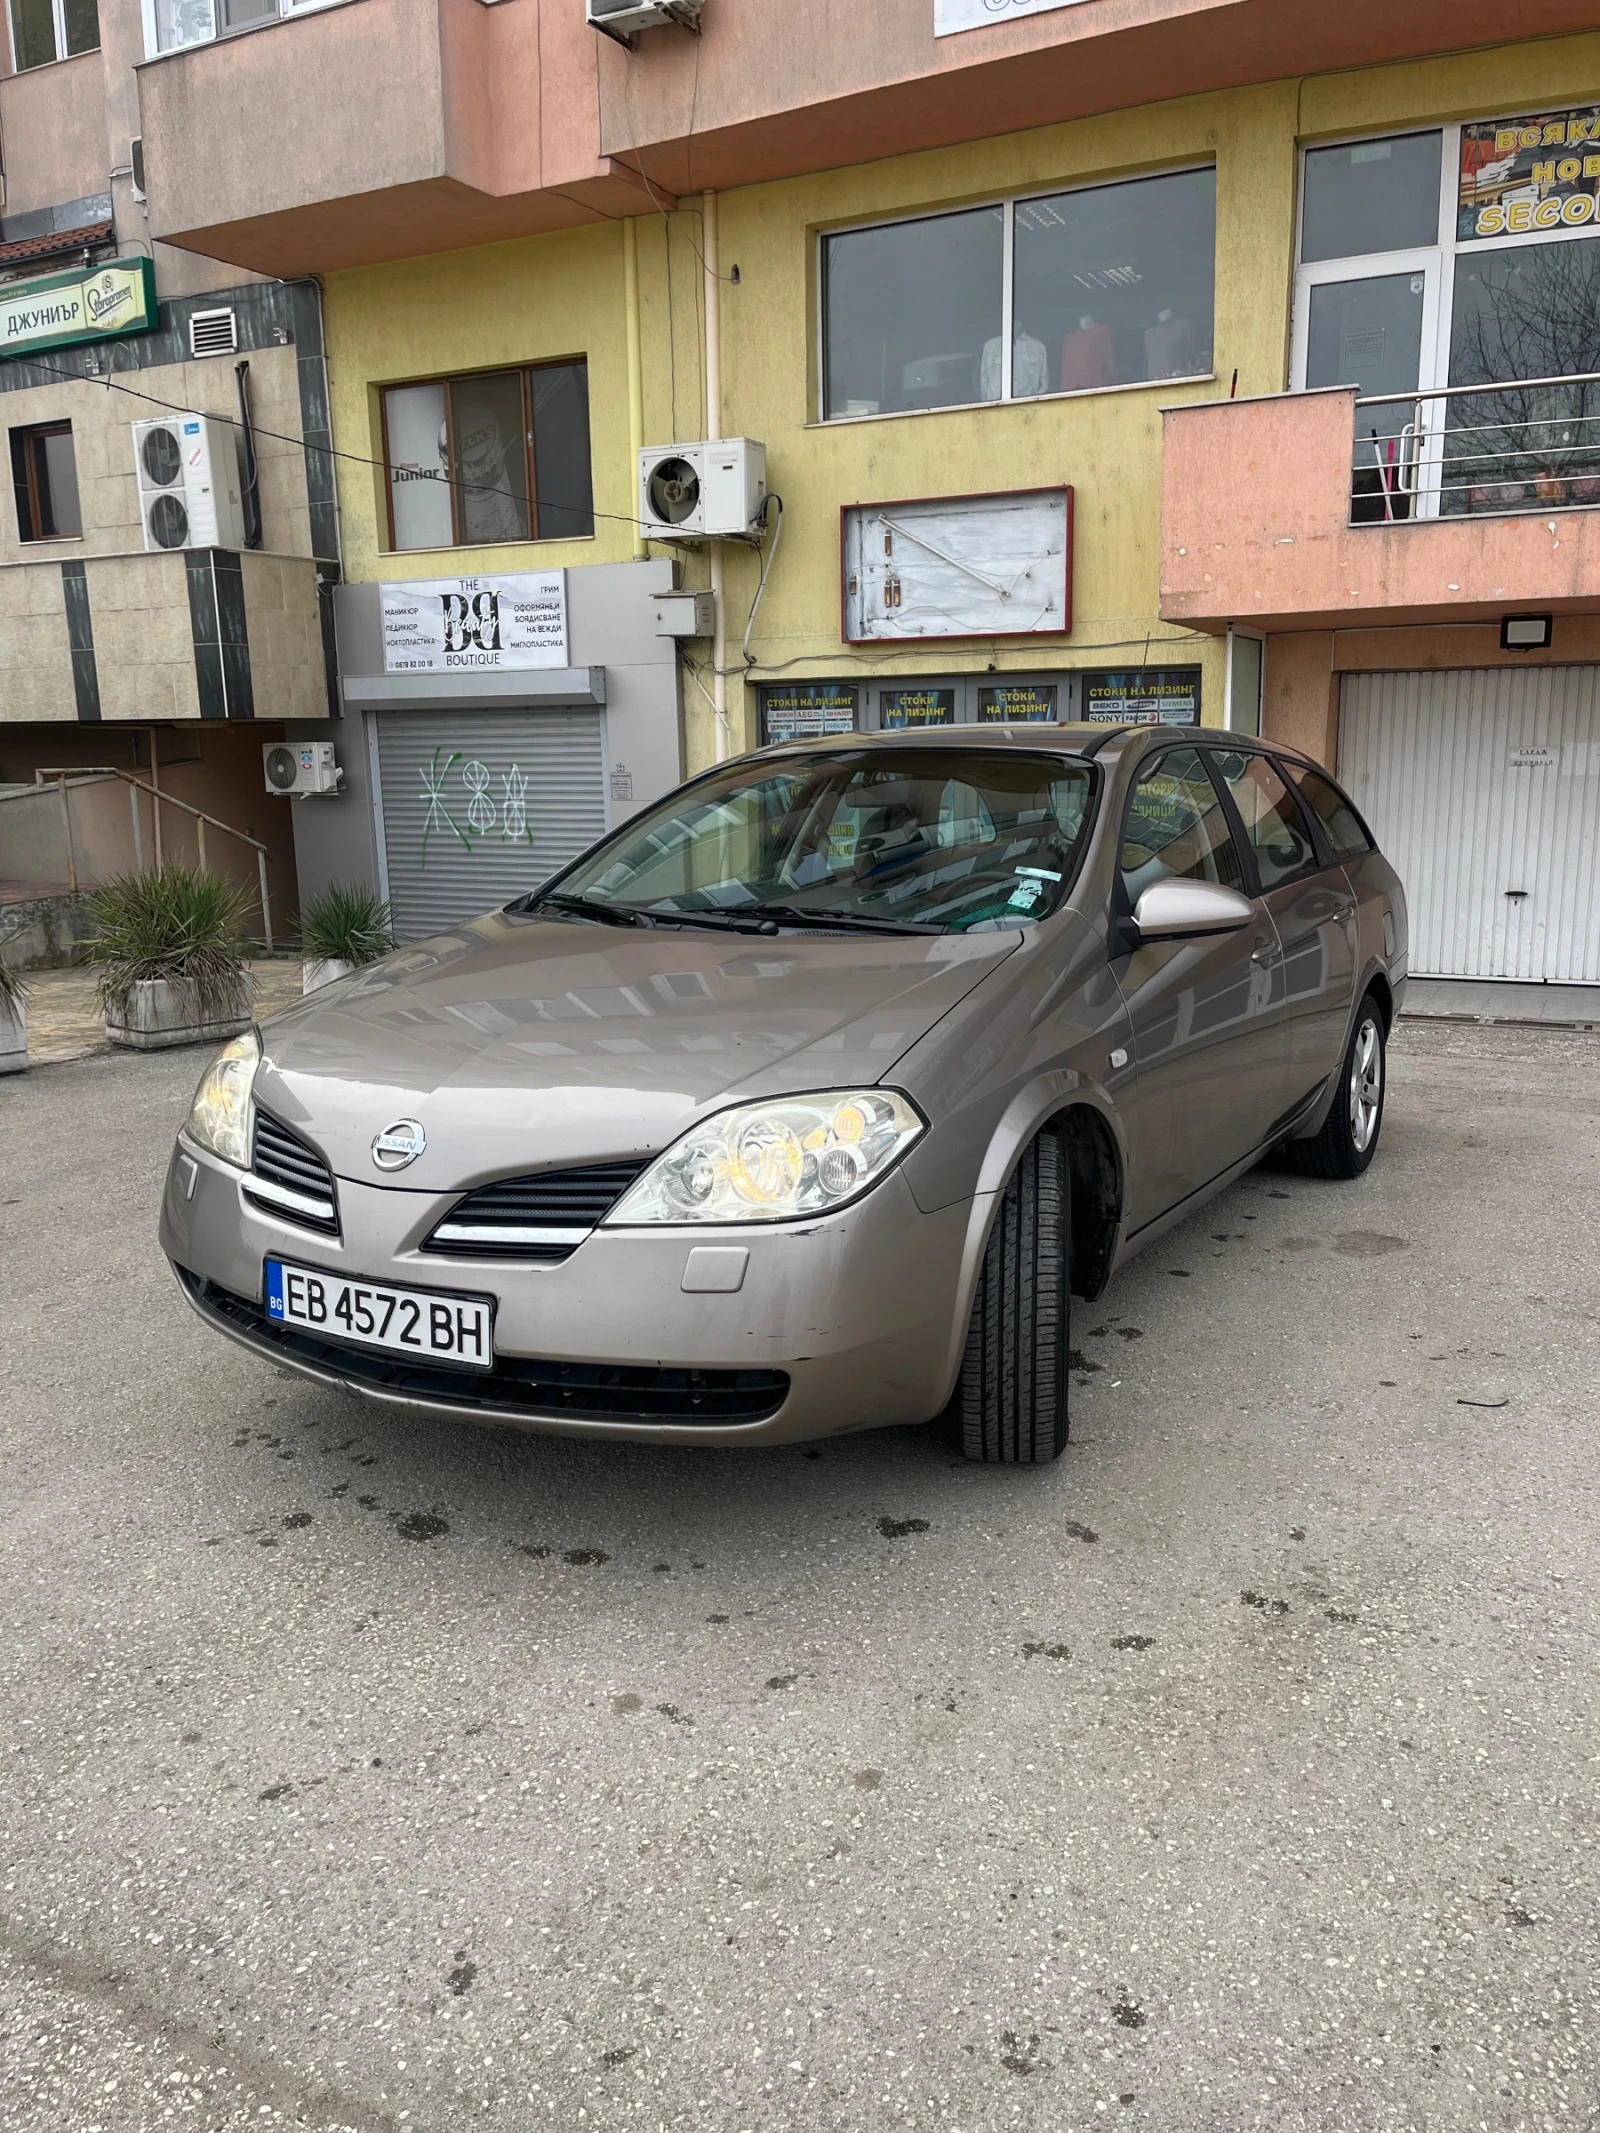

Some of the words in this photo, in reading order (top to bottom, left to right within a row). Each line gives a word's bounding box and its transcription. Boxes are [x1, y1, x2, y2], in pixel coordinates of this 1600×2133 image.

[1475, 193, 1600, 236] SECO
[87, 285, 134, 322] Staropramen
[7, 301, 80, 337] ДЖУНИЪР
[392, 467, 440, 483] Junior
[459, 580, 480, 591] THE
[385, 607, 419, 616] МАНИКЮР
[444, 605, 499, 641] Beauty
[515, 613, 561, 623] БОЯДИСВАНЕ
[386, 623, 418, 632] ПЕДИКЮР
[538, 625, 562, 633] ВЕЖДИ
[387, 637, 436, 646] НОКТОПЛАСТИКА
[510, 640, 564, 648] МИГЛОПЛАСТИКА
[446, 653, 501, 666] BOUTIQUE
[1089, 687, 1127, 697] СТОКИ
[1130, 686, 1145, 696] НА
[1149, 685, 1195, 695] ЛИЗИНГ
[900, 696, 934, 705] СТОКИ
[999, 692, 1036, 701] СТОКИ
[766, 698, 798, 708] СТОКИ
[800, 698, 813, 707] НА
[814, 696, 853, 707] ЛИЗИНГ
[889, 708, 902, 717] НА
[905, 707, 946, 717] ЛИЗИНГ
[986, 705, 1001, 714] НА
[1004, 703, 1048, 713] ЛИЗИНГ
[797, 710, 812, 718] AEG
[1090, 714, 1121, 722] SONY
[770, 723, 793, 731] gorenje
[826, 722, 851, 730] PHILIPS
[1136, 782, 1175, 796] АТОРИ
[270, 1295, 283, 1311] BG
[287, 1272, 327, 1324] EB
[335, 1286, 421, 1346] 4572
[429, 1302, 482, 1357] BH
